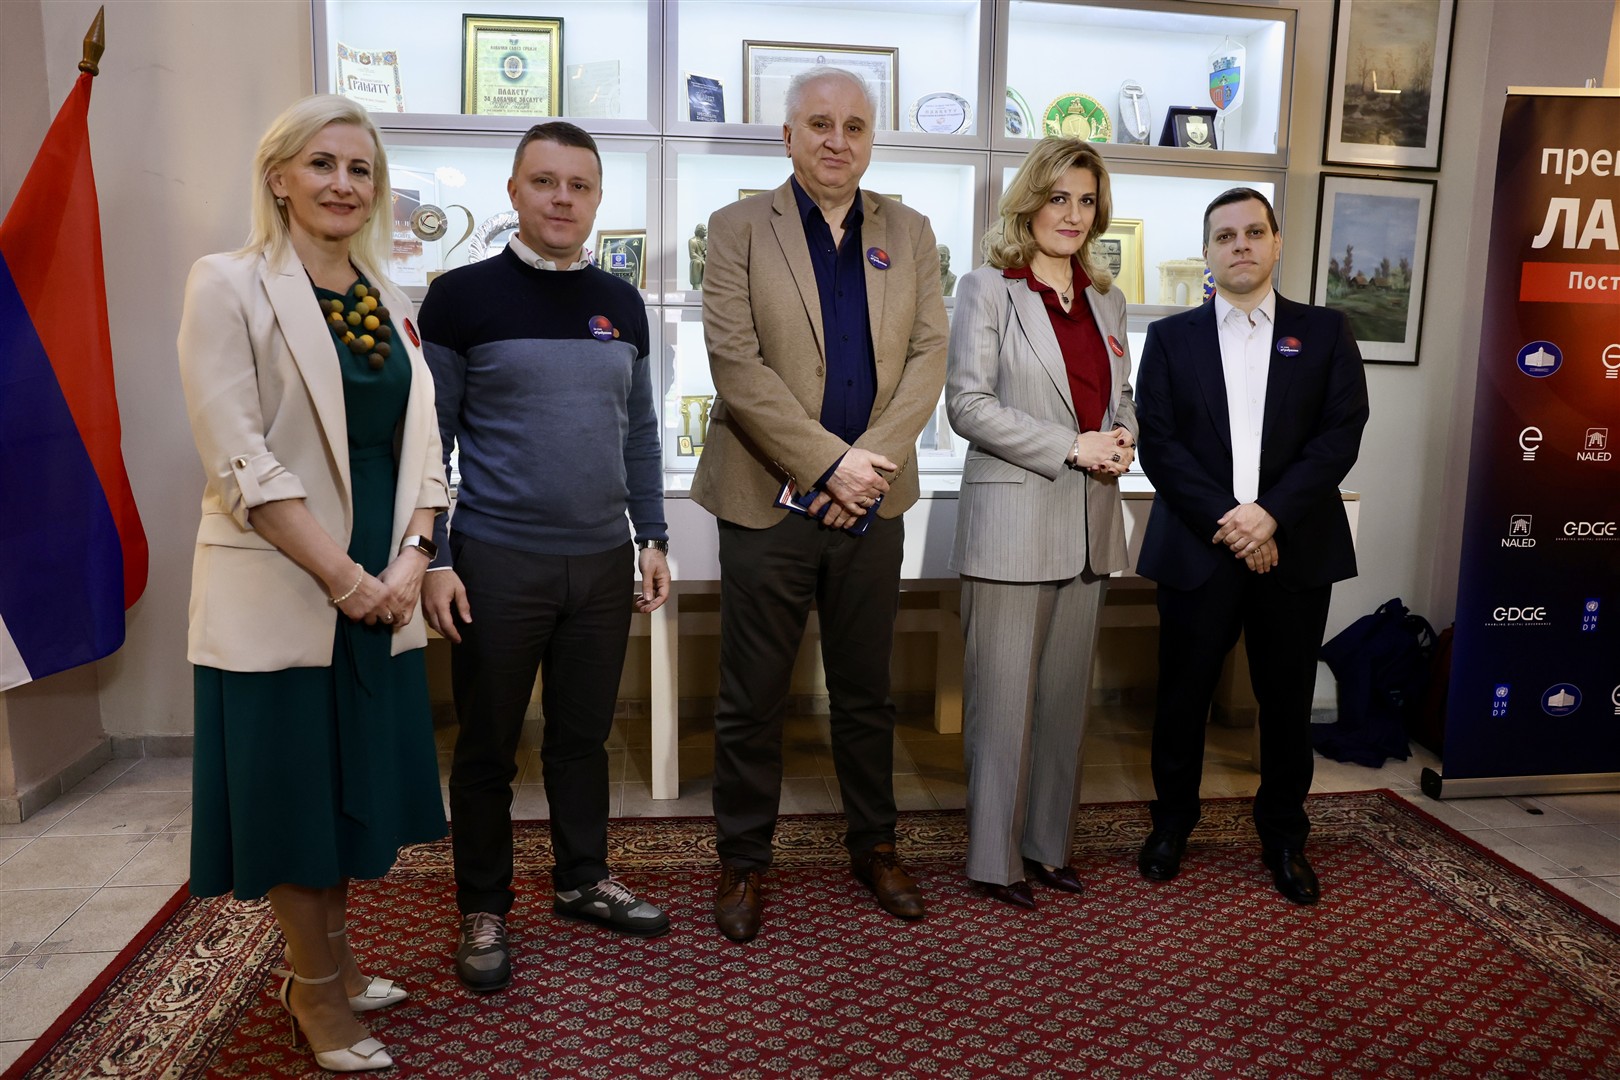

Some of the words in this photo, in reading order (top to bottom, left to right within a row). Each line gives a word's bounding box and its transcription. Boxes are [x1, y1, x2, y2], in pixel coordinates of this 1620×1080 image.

[1540, 148, 1620, 185] пре
[1576, 452, 1612, 462] NALED
[1501, 538, 1536, 548] NALED
